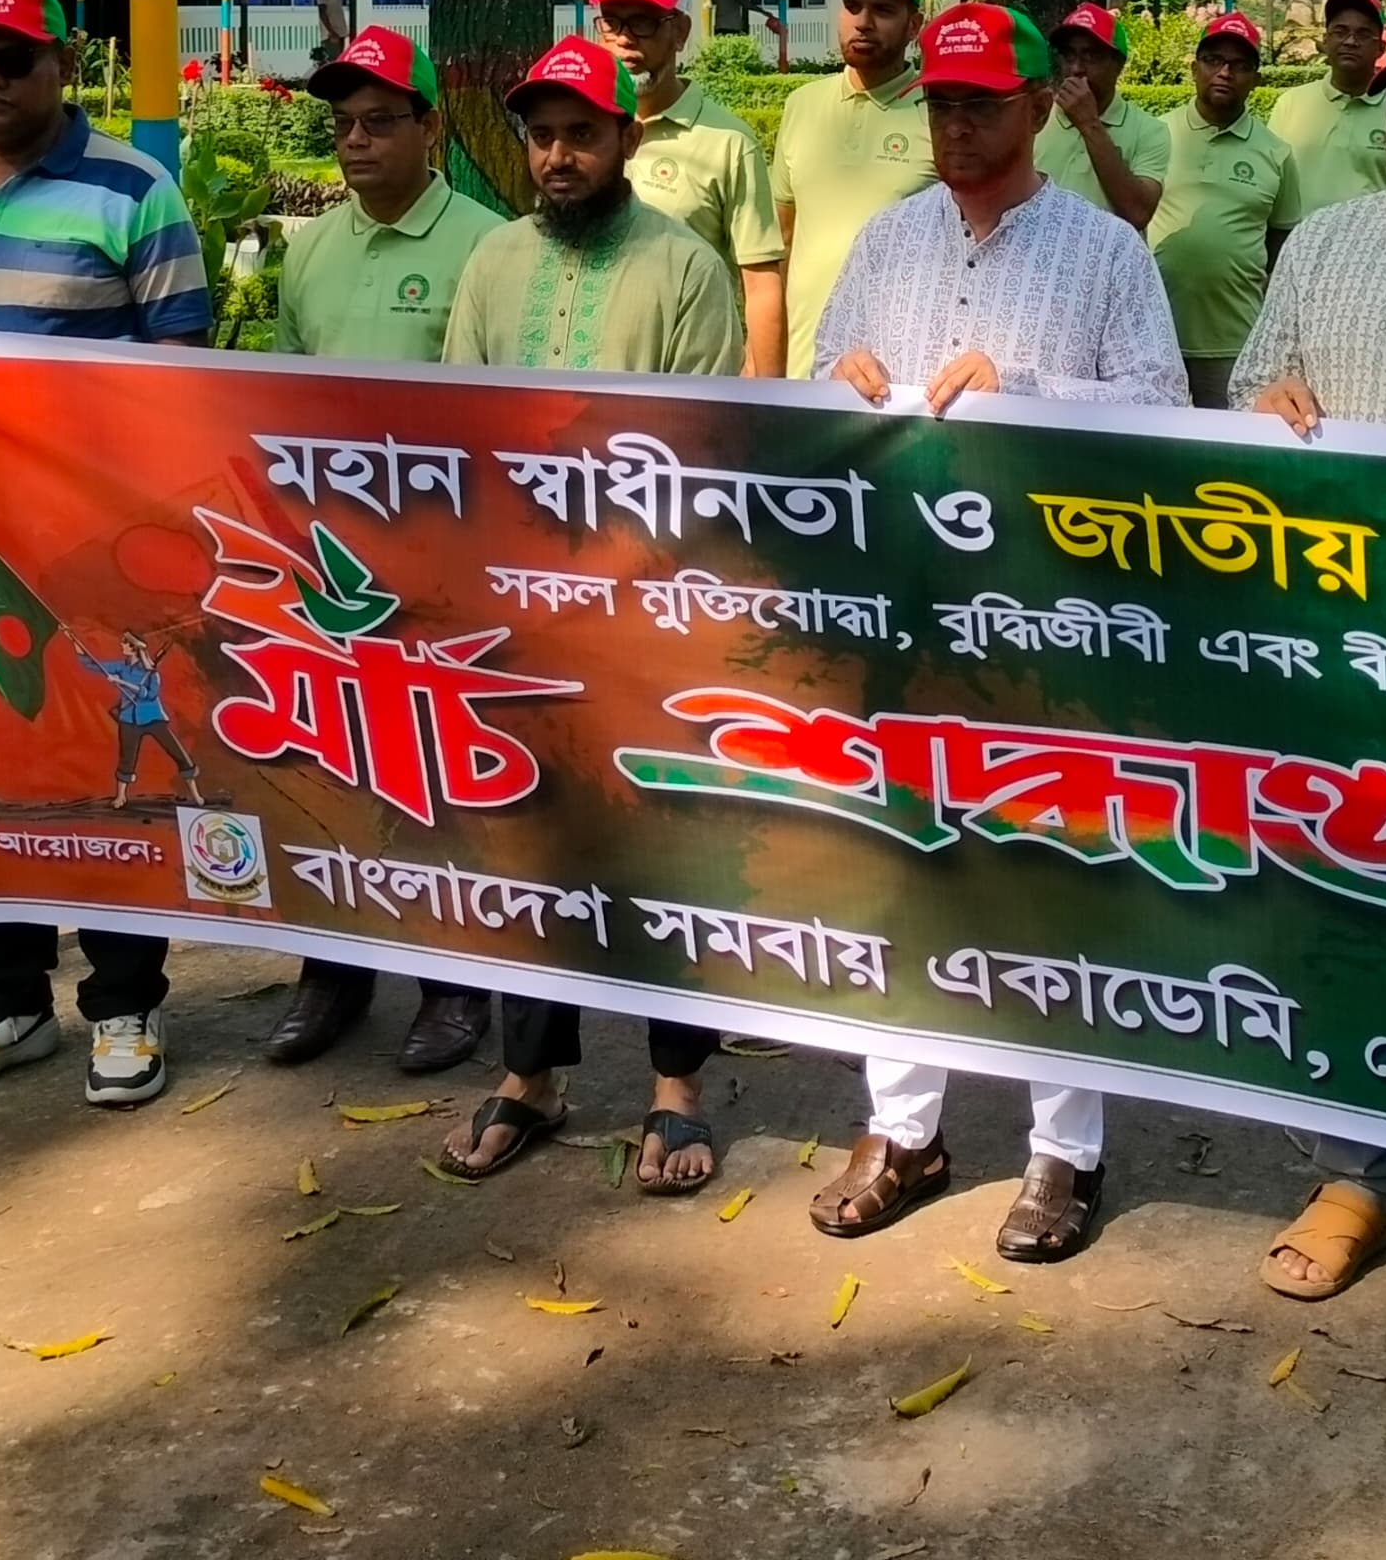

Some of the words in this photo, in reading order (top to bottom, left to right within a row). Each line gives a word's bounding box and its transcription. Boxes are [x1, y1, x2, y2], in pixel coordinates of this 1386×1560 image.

[192, 505, 401, 668] ২৬
[250, 432, 470, 520] মহান
[492, 431, 875, 552] স্বাধীনতা
[913, 490, 993, 552] ও
[1027, 481, 1379, 601] জাতীয়
[485, 565, 617, 617] সকল
[632, 568, 913, 652] মুক্তিযোদ্ধা,
[934, 590, 1170, 664] বুদ্ধিজীবী
[1199, 628, 1324, 681] এবং
[211, 627, 585, 828] মার্চ
[280, 840, 613, 950] বাংলাদেশ
[631, 896, 892, 995] সমবায়
[927, 943, 1331, 1081] একাডেমি,
